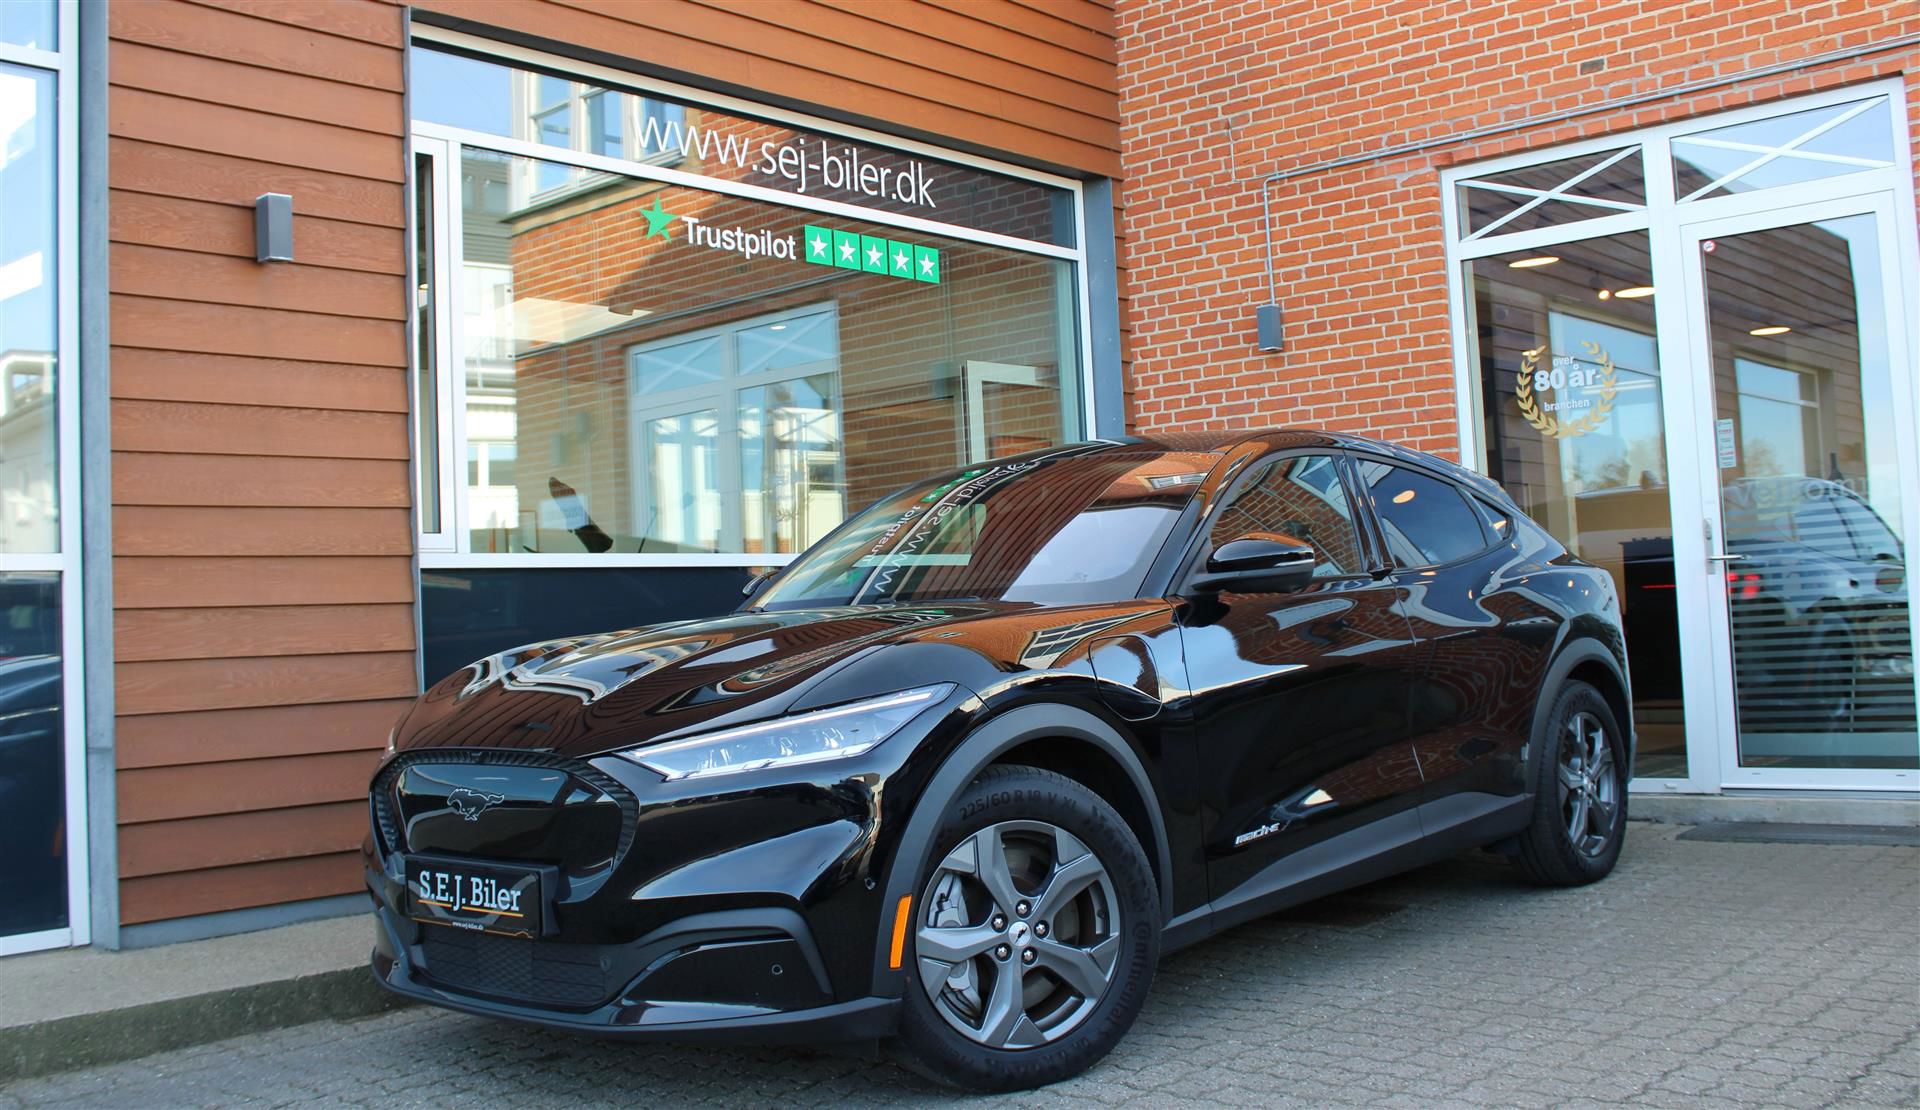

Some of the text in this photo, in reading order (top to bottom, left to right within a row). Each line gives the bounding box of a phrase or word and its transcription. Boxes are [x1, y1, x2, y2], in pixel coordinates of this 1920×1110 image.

[634, 116, 936, 208] www.sej-biler.dk
[681, 216, 797, 260] Trustpilot
[1553, 356, 1573, 366] over
[1534, 368, 1566, 391] 80
[1544, 399, 1590, 412] branchen
[958, 791, 1010, 820] 225/60
[420, 871, 521, 912] S.E.J. Biler
